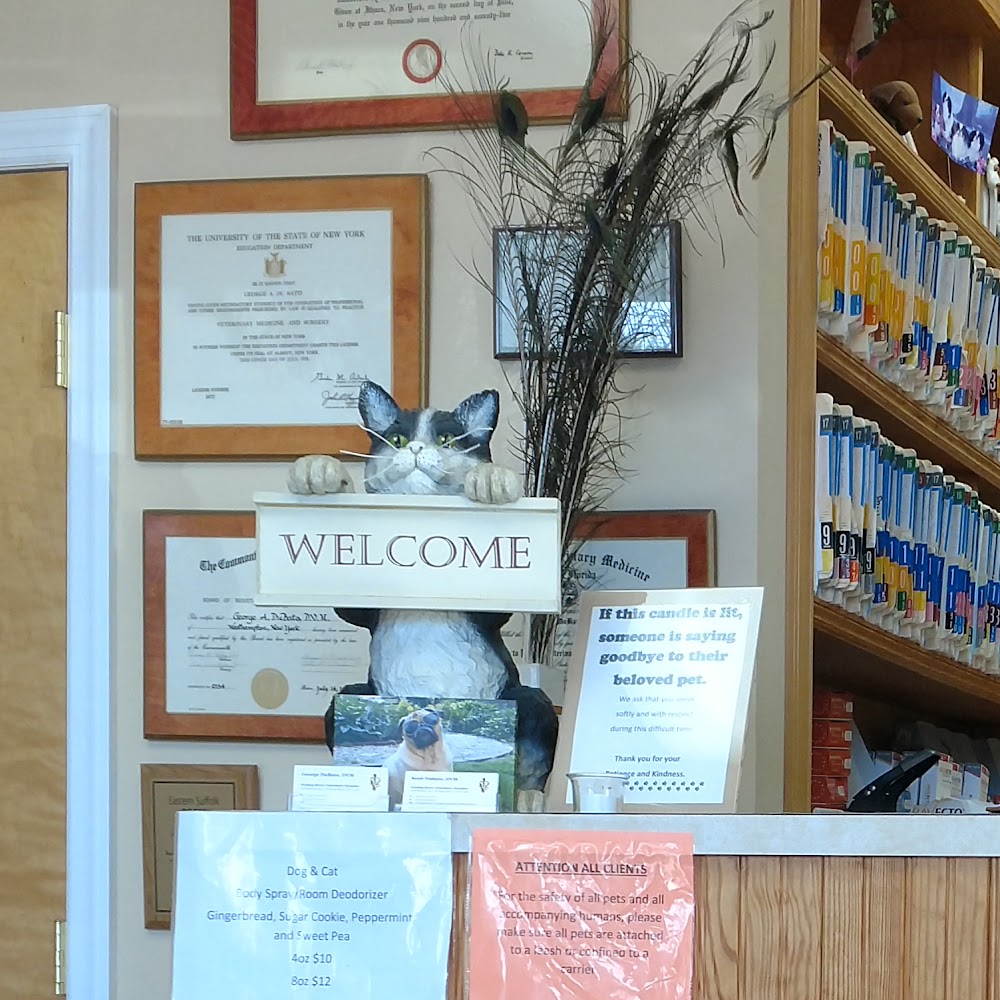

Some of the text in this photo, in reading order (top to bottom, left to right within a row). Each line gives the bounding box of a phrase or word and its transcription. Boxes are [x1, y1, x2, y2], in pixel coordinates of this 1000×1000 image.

[822, 525, 831, 548] 9
[279, 534, 531, 568] WELCOME
[601, 553, 650, 582] Medicine
[599, 607, 743, 620] If this candle is lit,
[599, 630, 736, 643] someone is saying
[600, 650, 728, 664] goodbye to their
[613, 674, 706, 687] beloved pet.
[287, 866, 338, 879] Dog & Cat
[515, 862, 647, 874] ATTENTION ALL CLIENTS
[332, 890, 388, 900] Deodorizer
[207, 910, 412, 924] Gingerbread, Sugar Cookie, Peppermint
[274, 931, 293, 940] and
[332, 932, 350, 941] Pea
[291, 953, 332, 965] 4oz $10
[291, 975, 331, 987] 8oz $12
